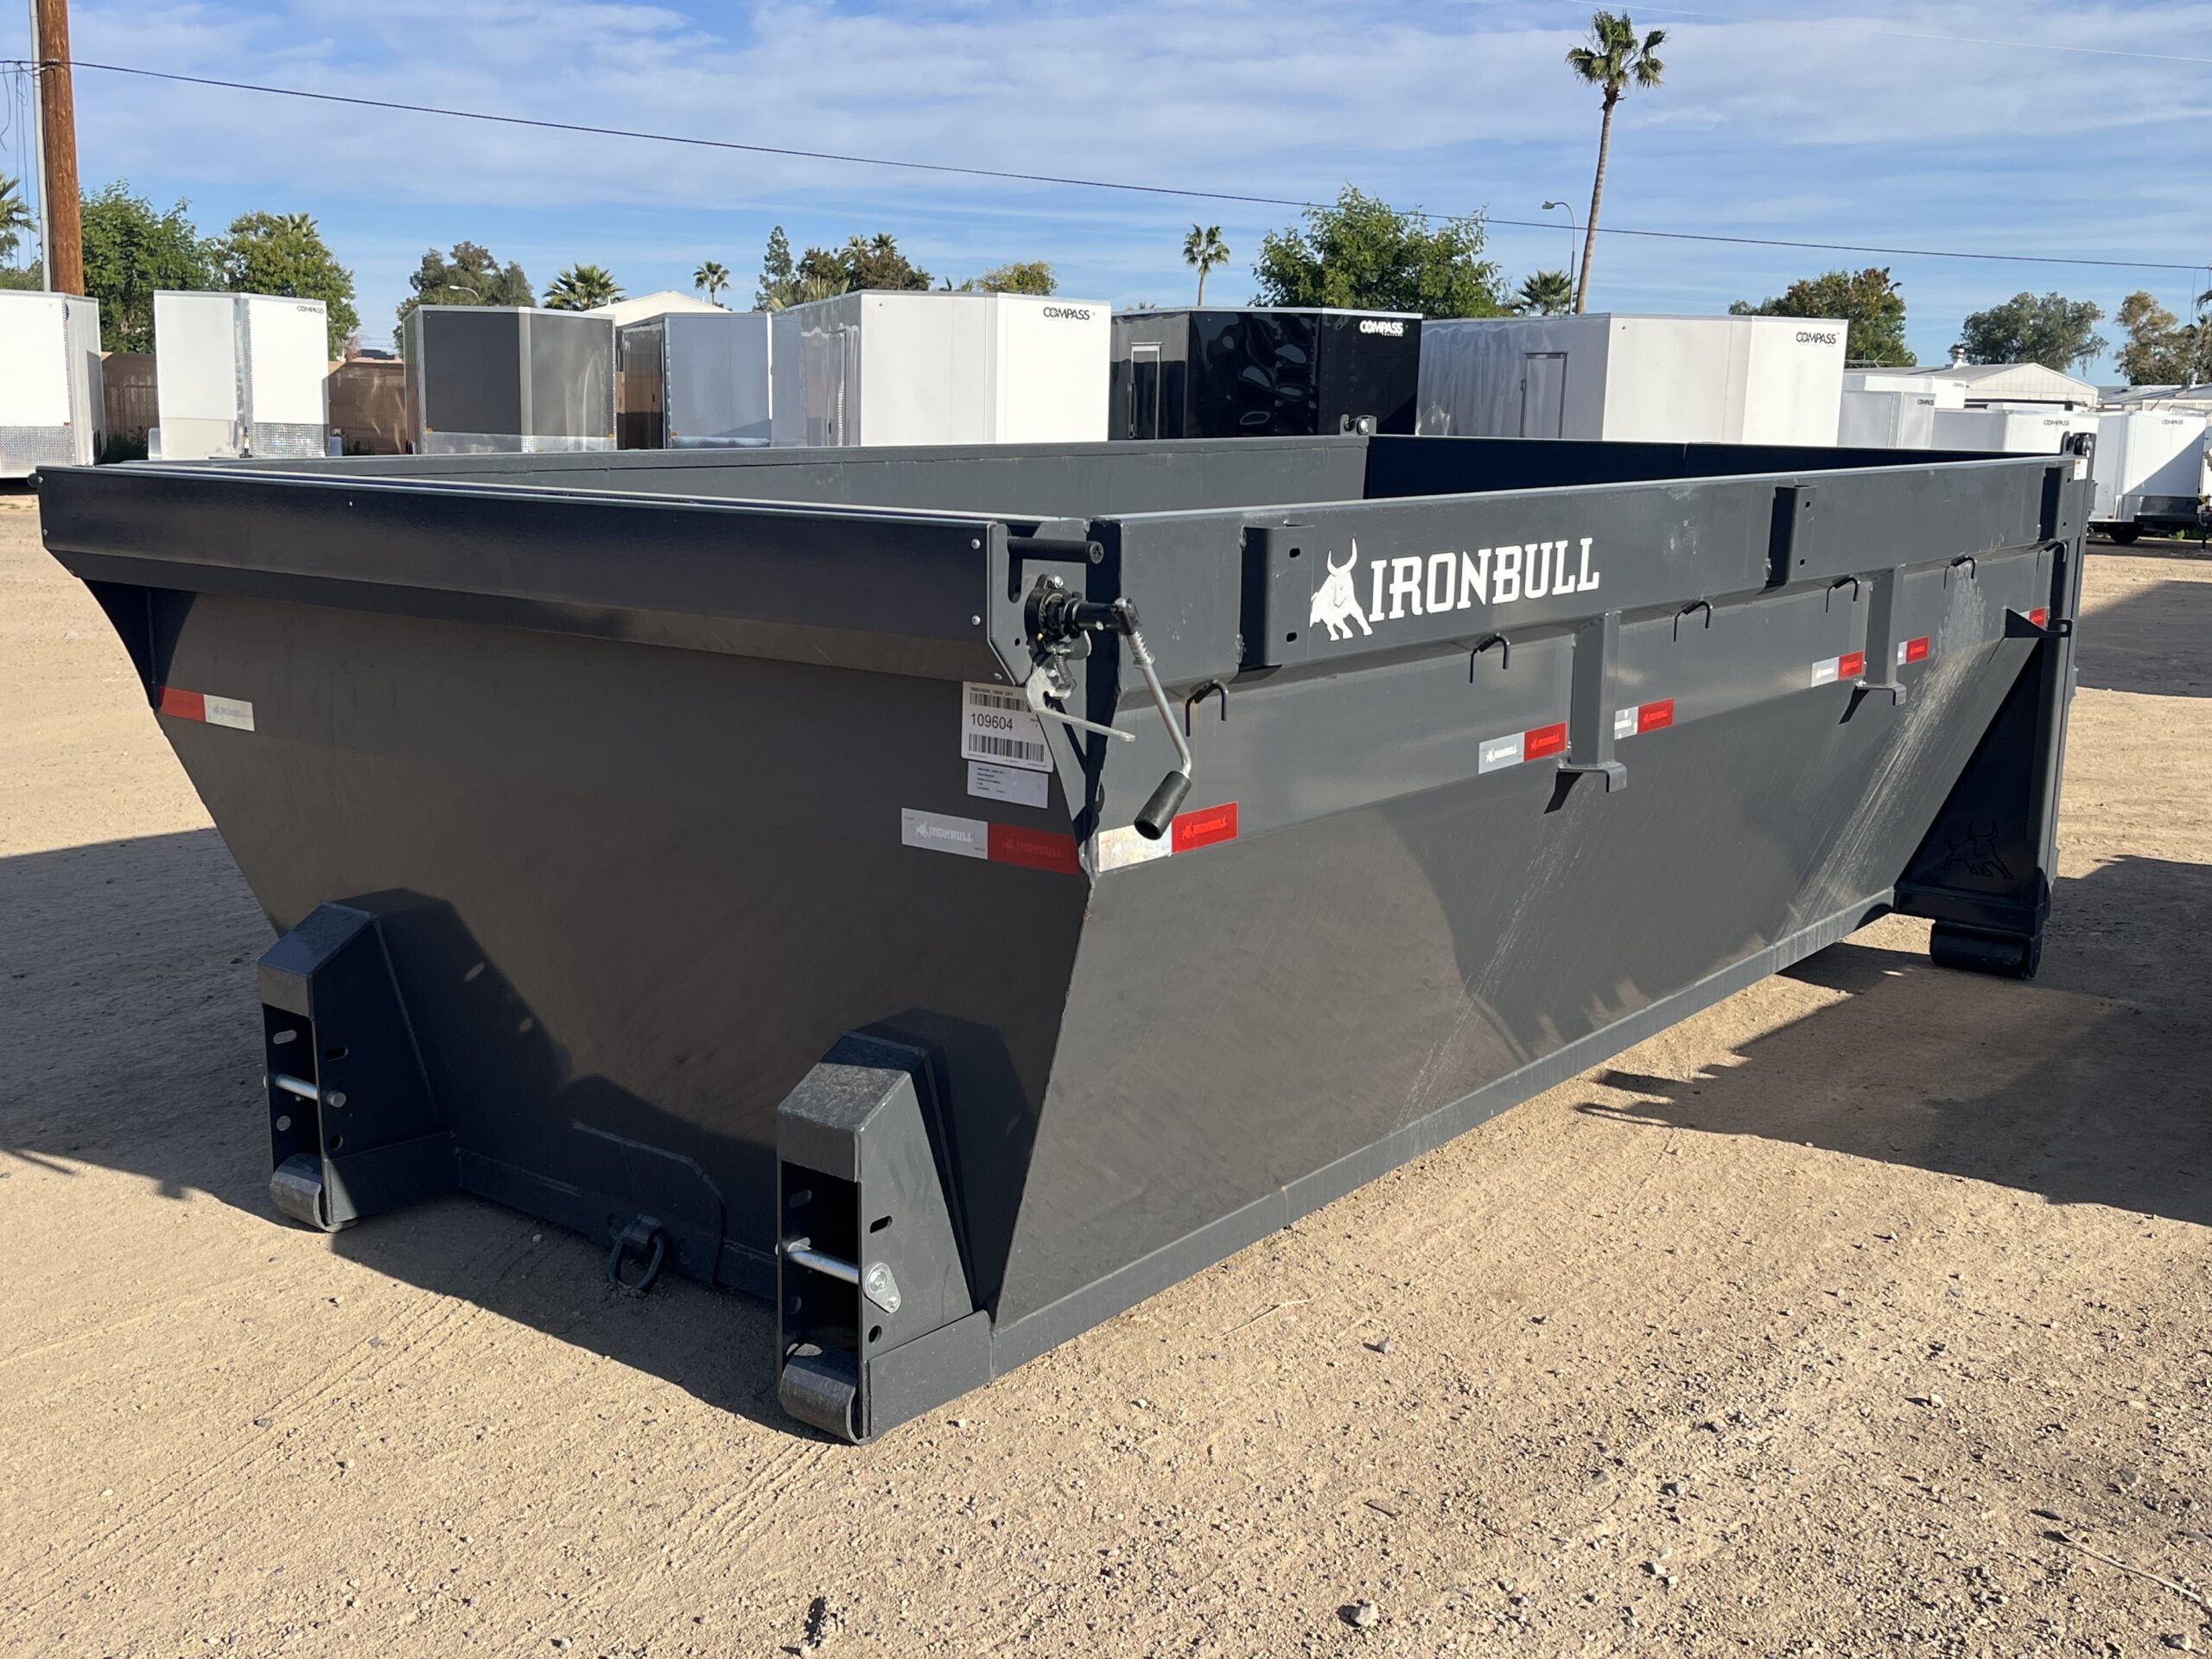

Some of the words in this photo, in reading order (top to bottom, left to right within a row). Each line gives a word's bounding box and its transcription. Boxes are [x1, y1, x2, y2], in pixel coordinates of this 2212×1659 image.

[1043, 307, 1090, 321] COMPASS
[1359, 320, 1404, 334] COMPASS
[1796, 332, 1836, 344] COMPASS
[1369, 537, 1599, 622] IRONBULL
[970, 713, 1013, 731] 109604
[929, 826, 973, 842] IRONBULL
